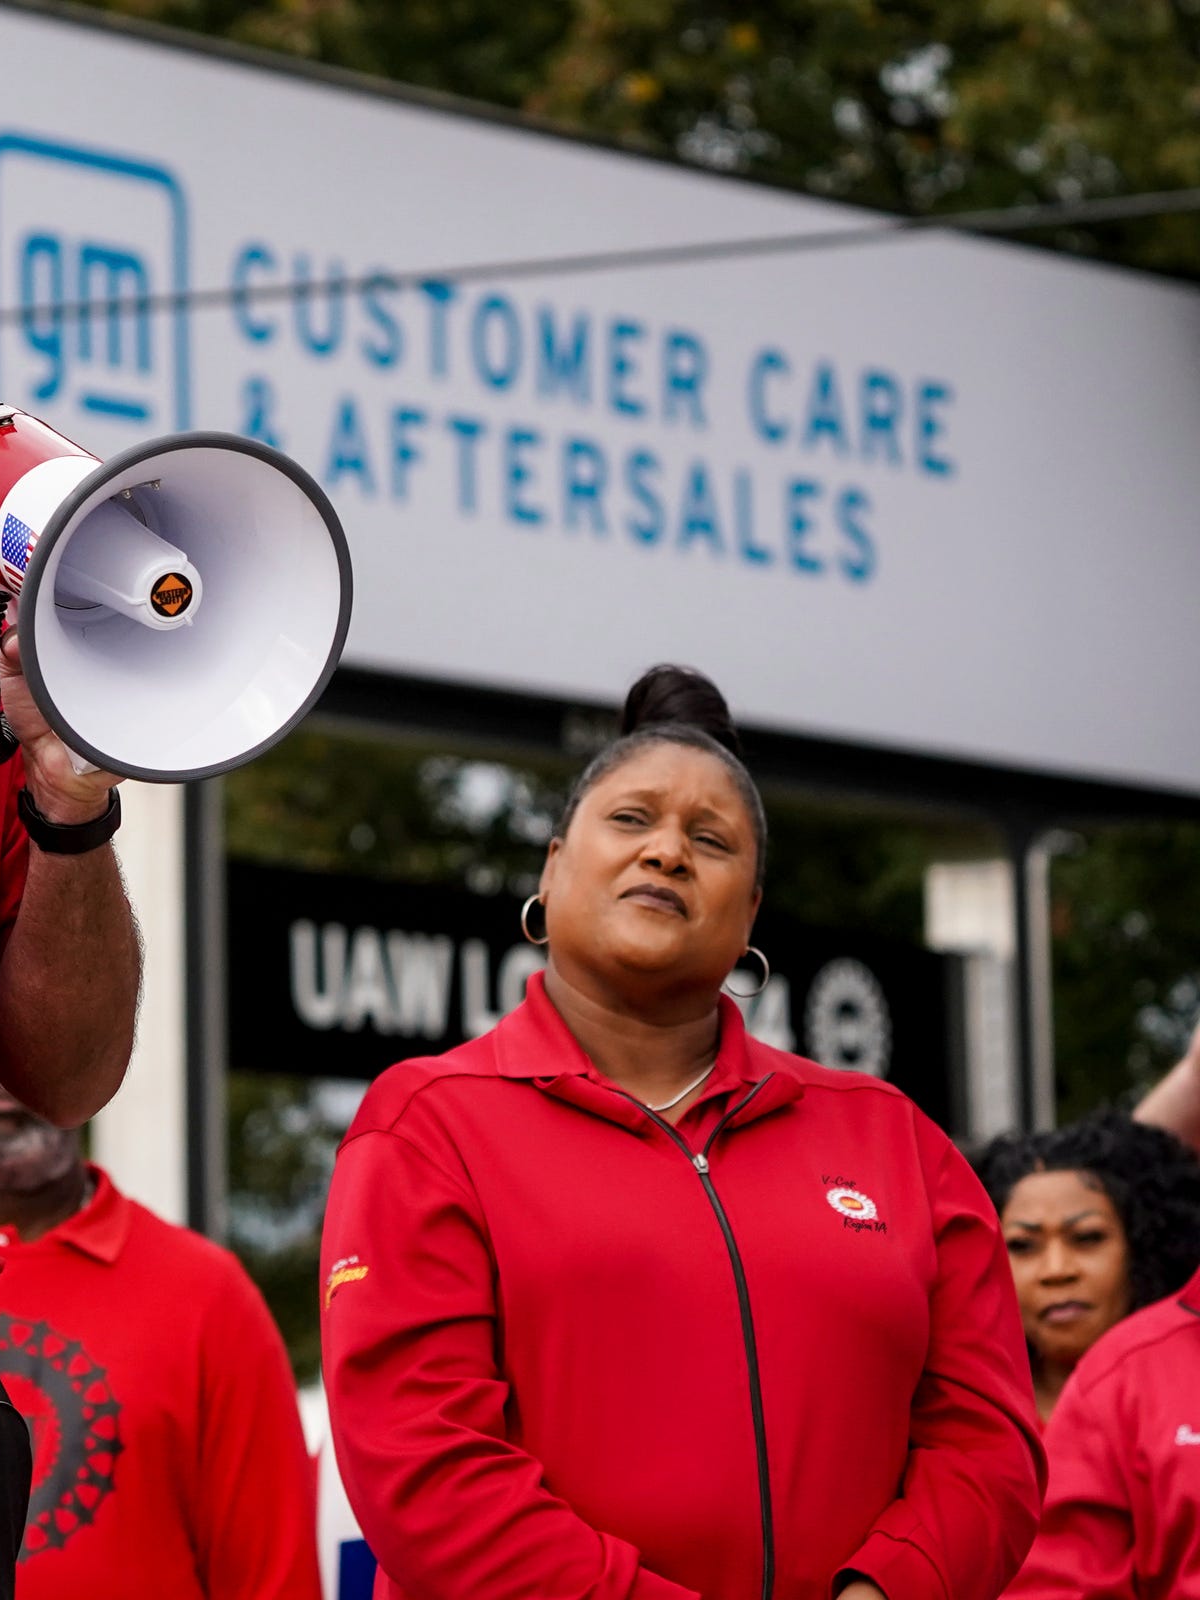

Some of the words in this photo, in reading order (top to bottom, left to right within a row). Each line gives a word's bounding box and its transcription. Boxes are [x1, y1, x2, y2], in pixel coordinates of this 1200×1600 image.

[21, 234, 152, 401] gm
[231, 242, 709, 428] CUSTOMER
[746, 345, 957, 480] CARE
[326, 397, 878, 585] AFTERSALES
[289, 917, 454, 1041] UAW
